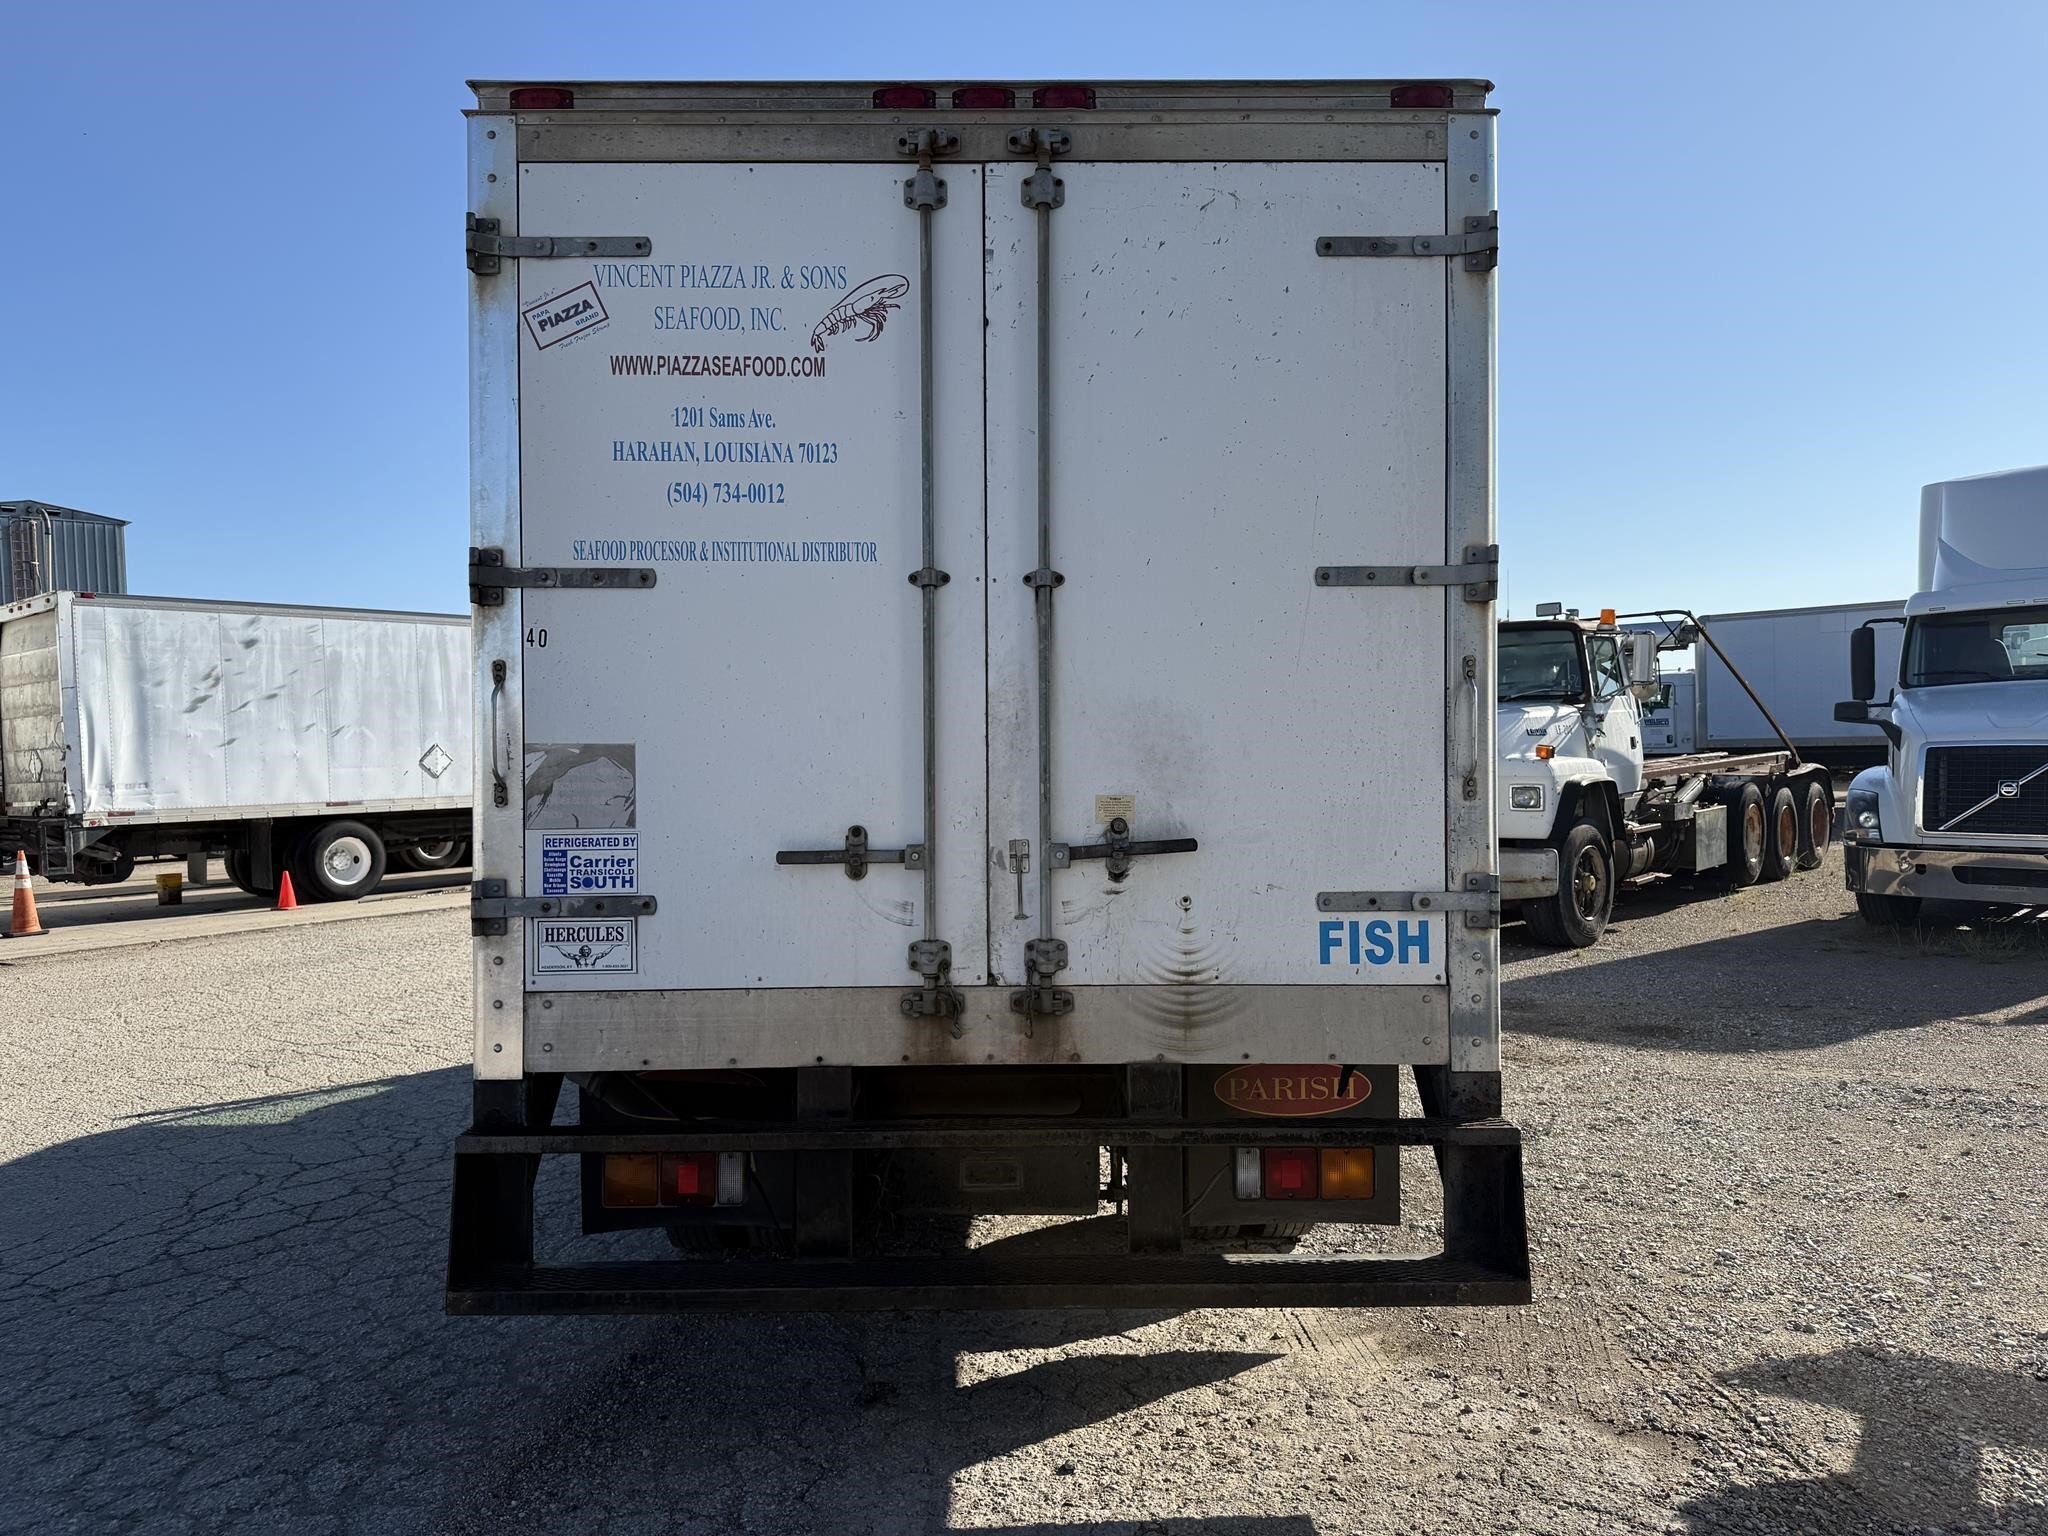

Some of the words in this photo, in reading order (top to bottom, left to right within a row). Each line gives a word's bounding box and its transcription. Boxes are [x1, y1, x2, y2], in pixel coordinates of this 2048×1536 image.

[593, 263, 676, 289] VINCENT
[680, 264, 747, 290] PIAZZA
[751, 265, 776, 290] JR.
[780, 265, 795, 290] &
[800, 265, 848, 291] SONS
[531, 308, 551, 321] PAPA
[537, 299, 595, 333] PIAZZA
[575, 311, 600, 327] BRAND
[654, 305, 746, 335] SEAFOOD,
[750, 307, 787, 332] INC.
[609, 354, 827, 378] WWW.PIAZZASEAFOOD.COM
[672, 406, 704, 428] 1201
[709, 406, 746, 429] Sams
[747, 407, 776, 429] Ave.
[612, 440, 700, 466] HARAHAN,
[703, 441, 794, 464] LOUISIANA
[798, 442, 838, 464] 70123
[666, 481, 708, 508] (504)
[712, 482, 785, 504] 734-0012
[572, 539, 627, 561] SEAFOOD
[629, 539, 697, 562] PROCESSOR
[699, 540, 709, 562] &
[711, 540, 800, 562] INSTITUTIONAL
[801, 541, 878, 563] DISTRIBUTOR
[526, 627, 548, 648] 40
[545, 837, 620, 848] REFRIGERATED
[622, 836, 636, 848] BY
[569, 868, 635, 876] TRANSICOLD
[570, 855, 634, 868] Carrier
[544, 926, 625, 943] HERCULES
[1318, 919, 1430, 965] FISH
[1225, 1077, 1358, 1100] PARISH
